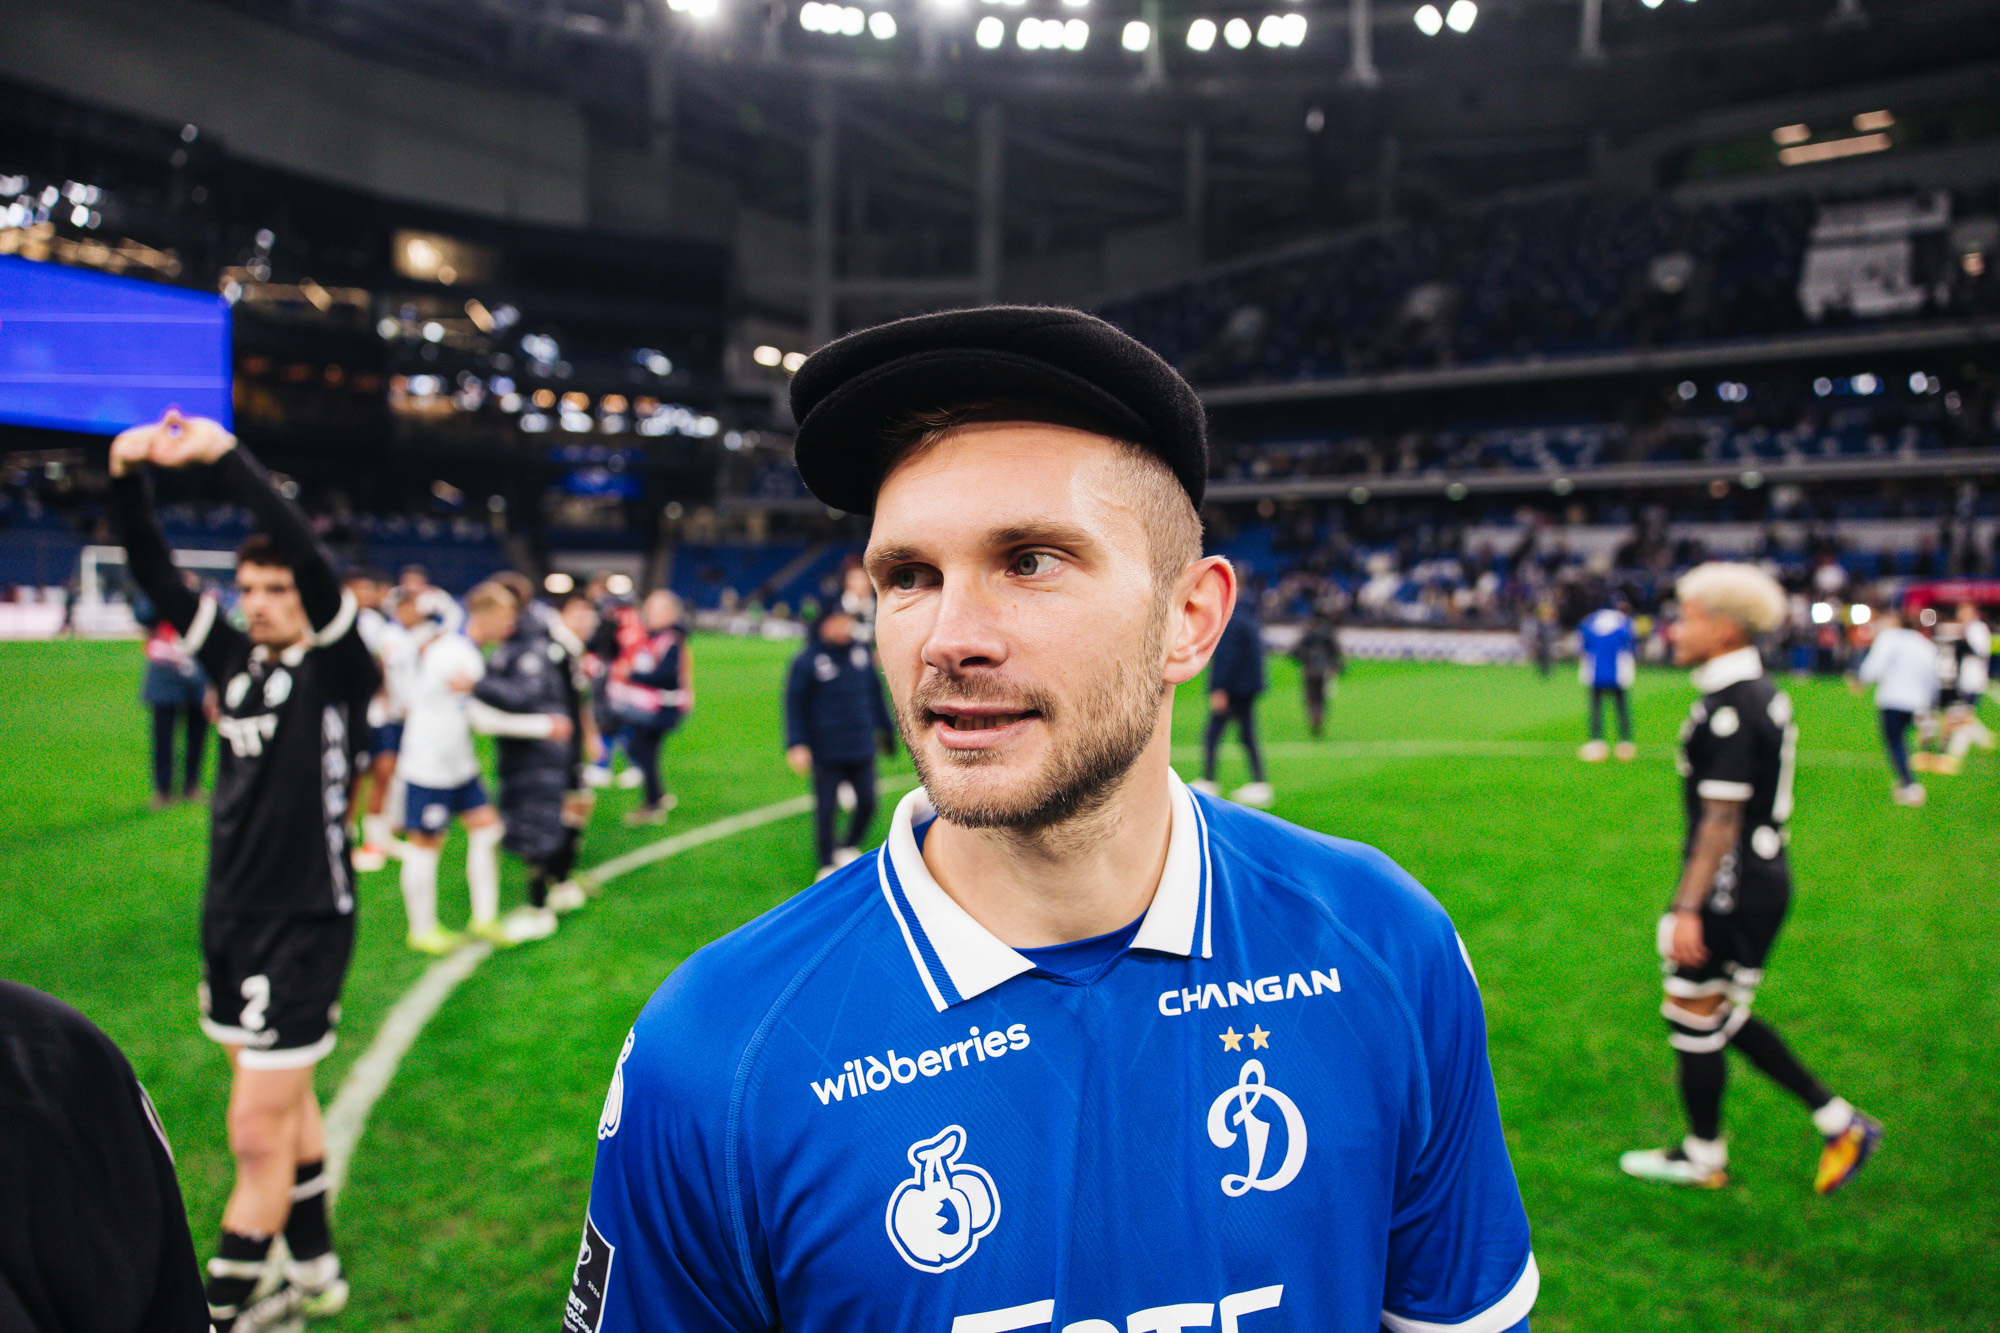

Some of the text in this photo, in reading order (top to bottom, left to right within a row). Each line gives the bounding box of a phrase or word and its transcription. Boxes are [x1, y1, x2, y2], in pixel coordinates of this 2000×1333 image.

[239, 974, 271, 1032] 2
[1158, 968, 1342, 1017] CHANGAN
[810, 1023, 1031, 1106] wildberries
